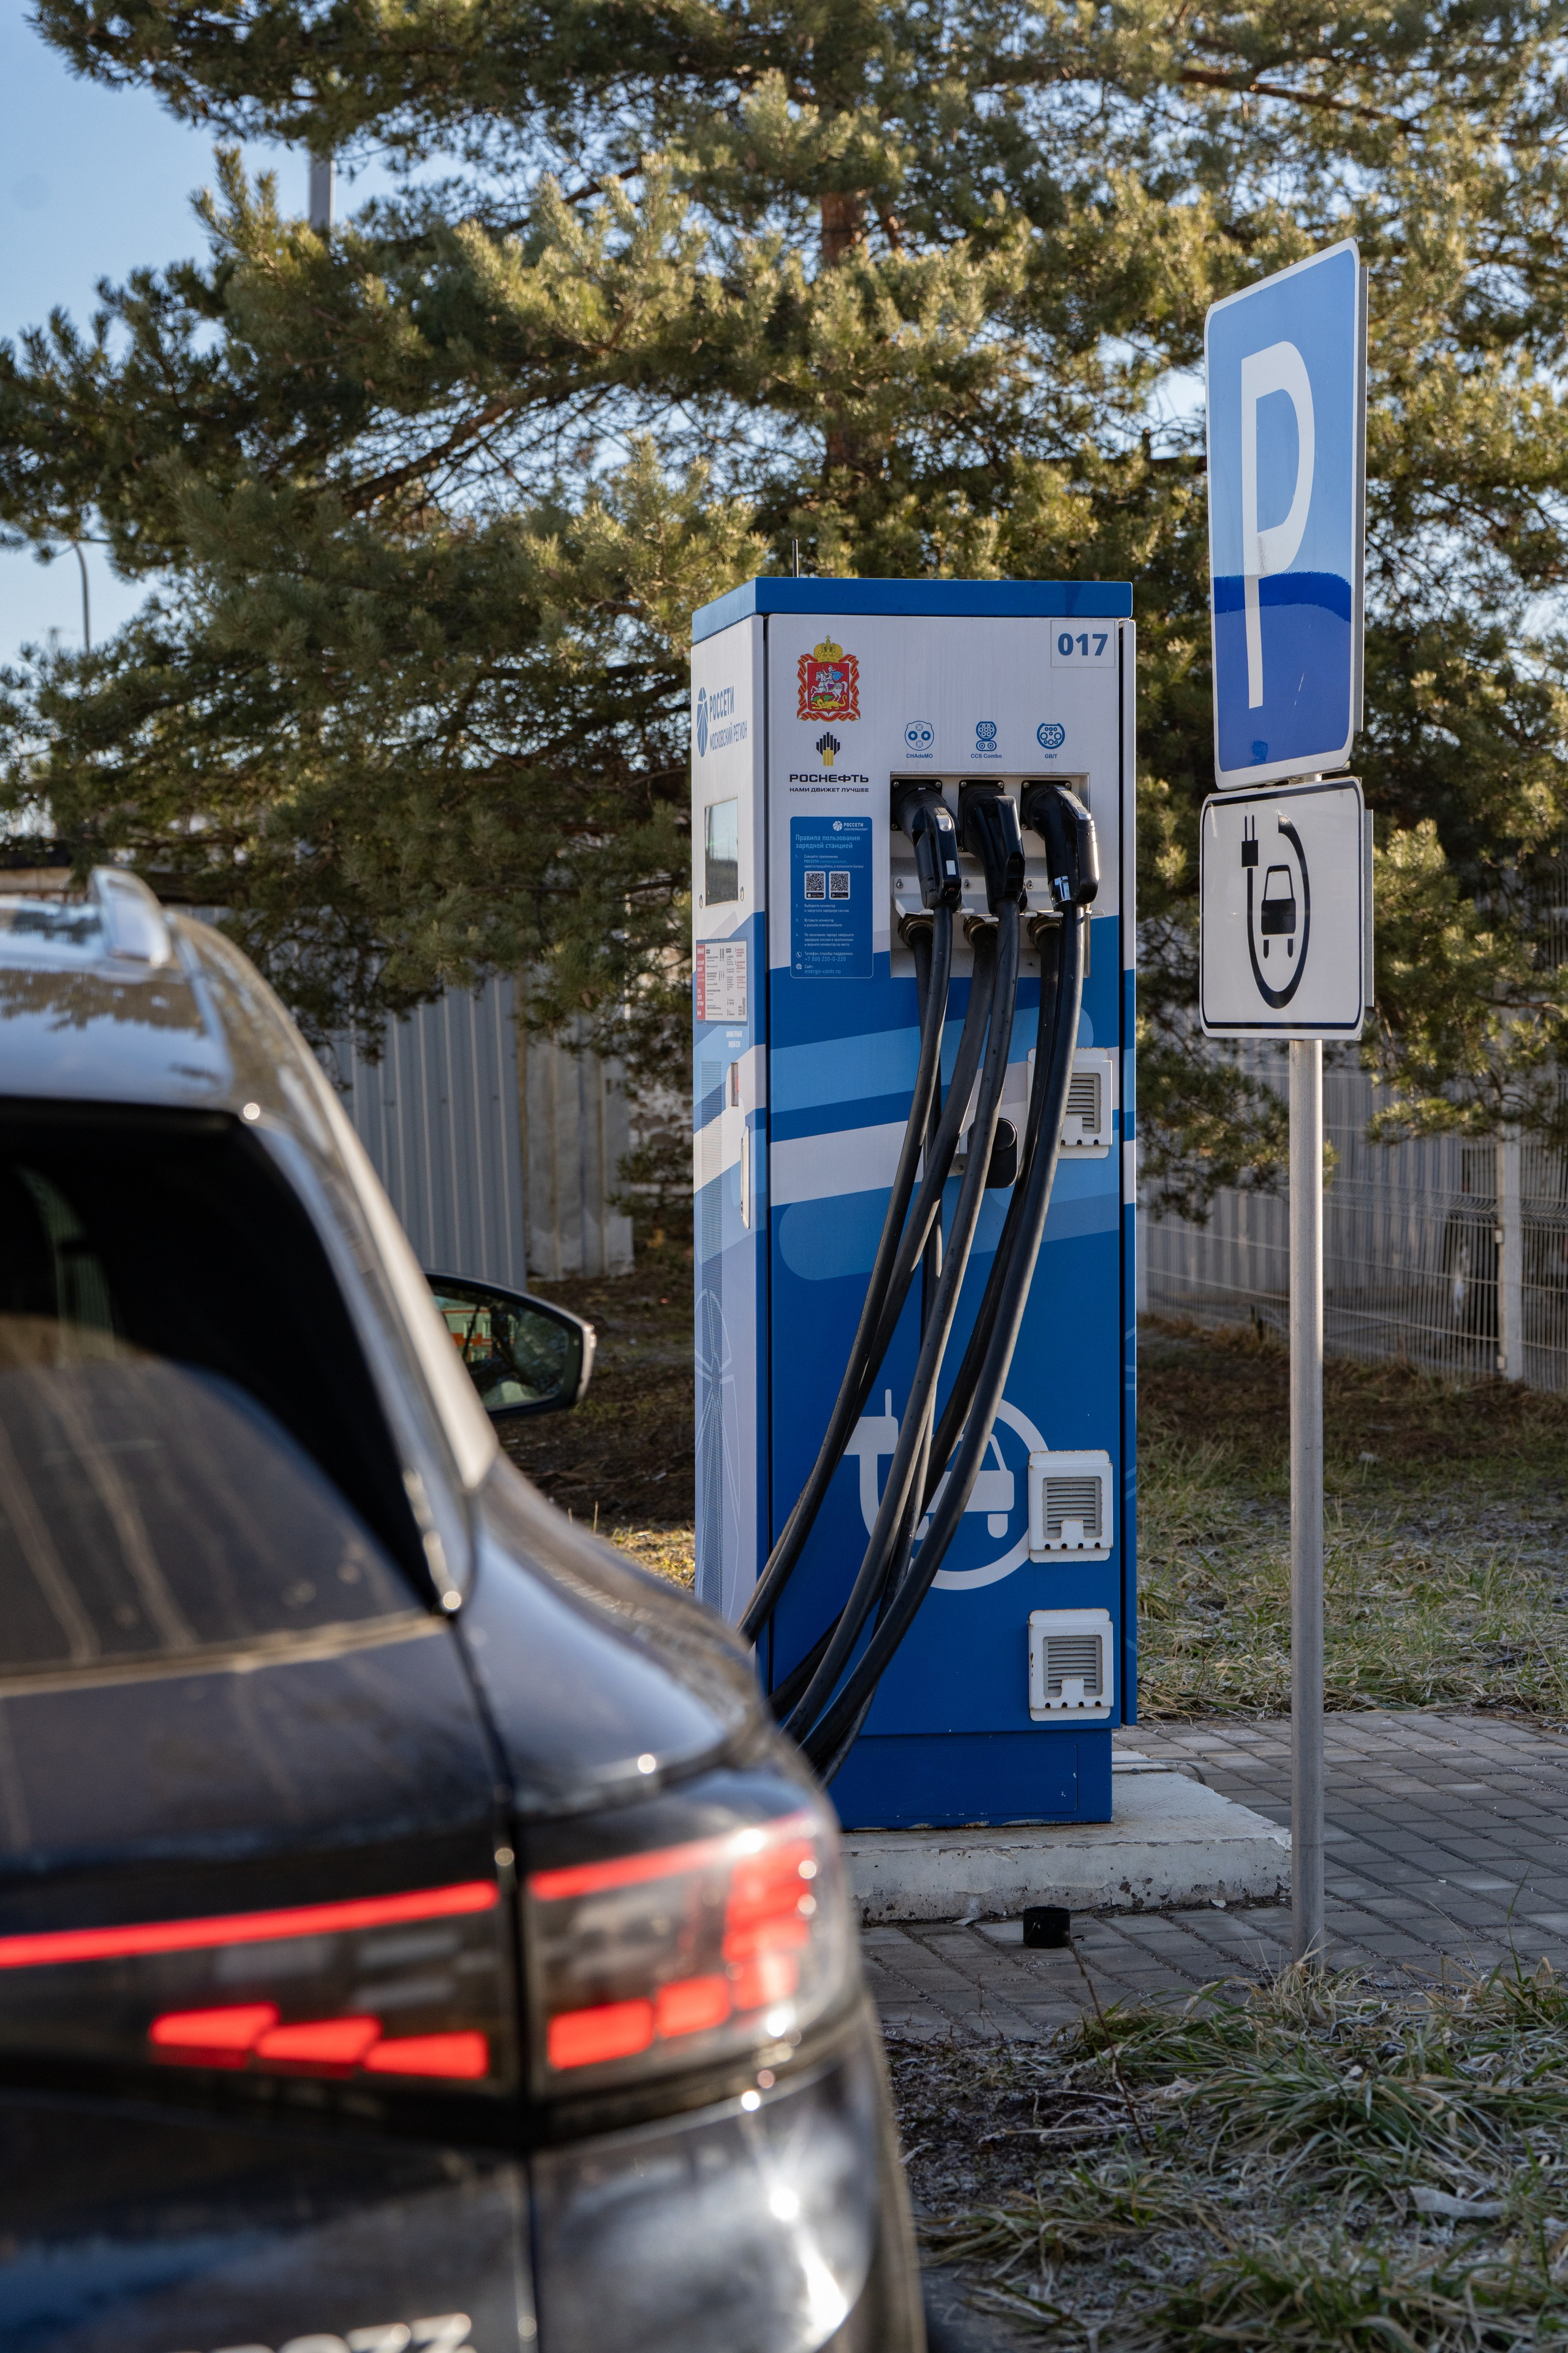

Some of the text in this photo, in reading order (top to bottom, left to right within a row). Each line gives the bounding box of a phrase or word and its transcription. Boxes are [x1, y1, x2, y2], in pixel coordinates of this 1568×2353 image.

[1242, 340, 1315, 709] P
[1058, 633, 1108, 656] 017
[709, 686, 734, 722] РОССЕТИ
[710, 720, 747, 752] МОСКОВСКИЙ РЕГИОН
